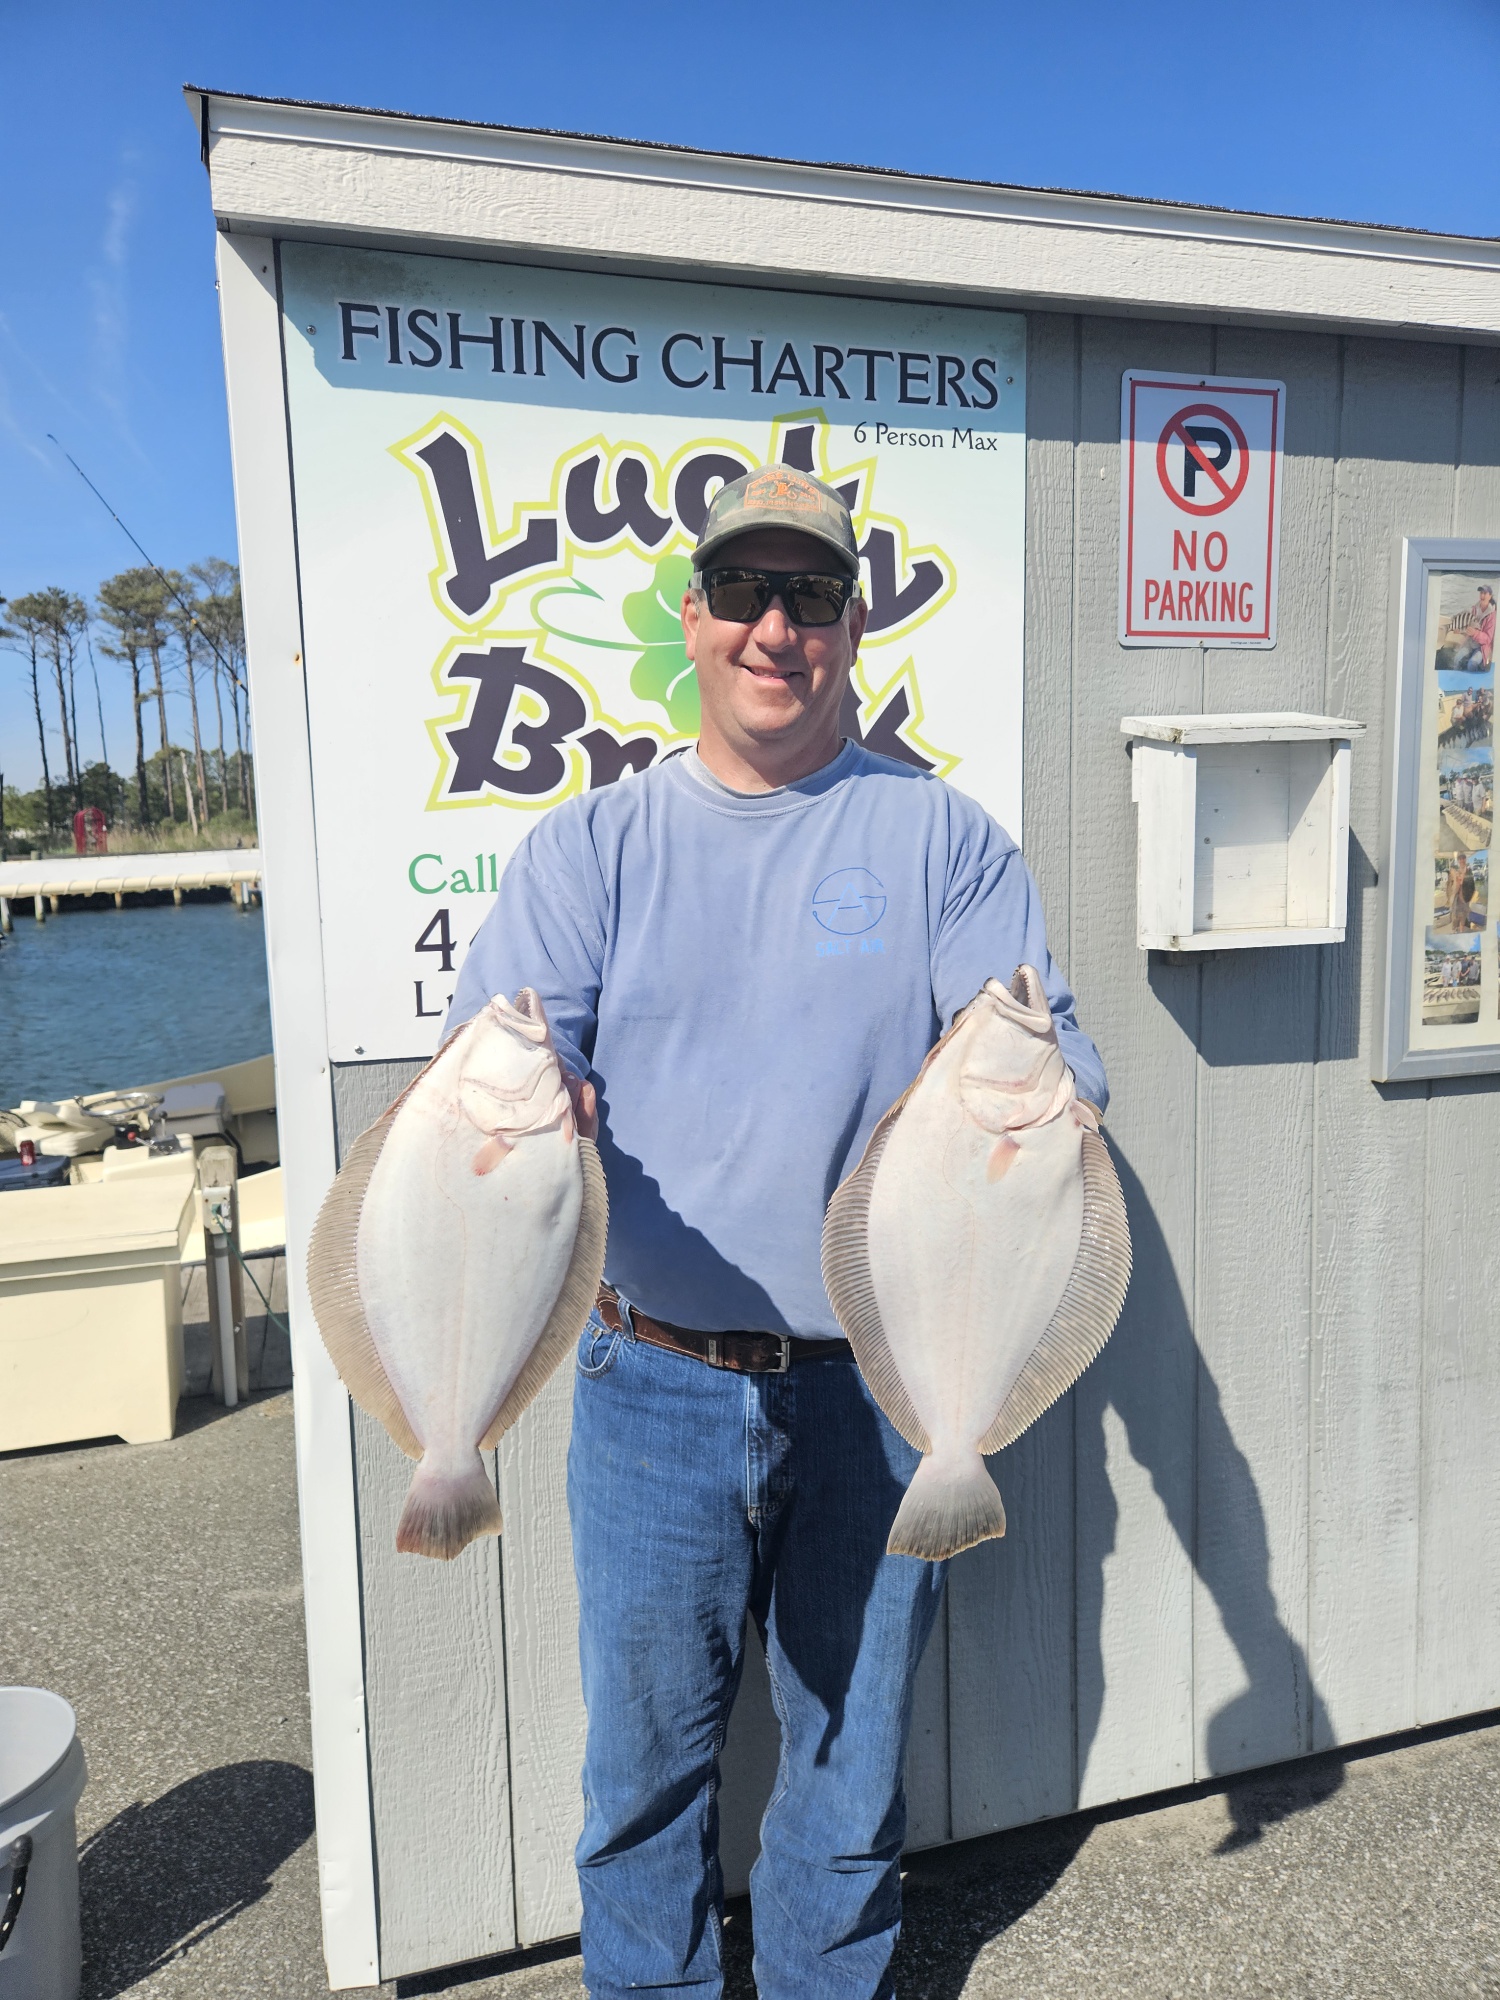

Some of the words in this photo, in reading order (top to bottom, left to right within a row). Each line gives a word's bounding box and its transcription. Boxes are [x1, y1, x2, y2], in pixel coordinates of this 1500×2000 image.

[338, 302, 640, 384] FISHING
[661, 333, 999, 410] CHARTERS
[854, 421, 867, 444] 6
[876, 422, 944, 448] Person
[952, 427, 998, 451] Max
[1173, 530, 1228, 572] NO
[1144, 579, 1254, 623] PARKING
[445, 646, 938, 794] Brk
[408, 853, 499, 894] Call
